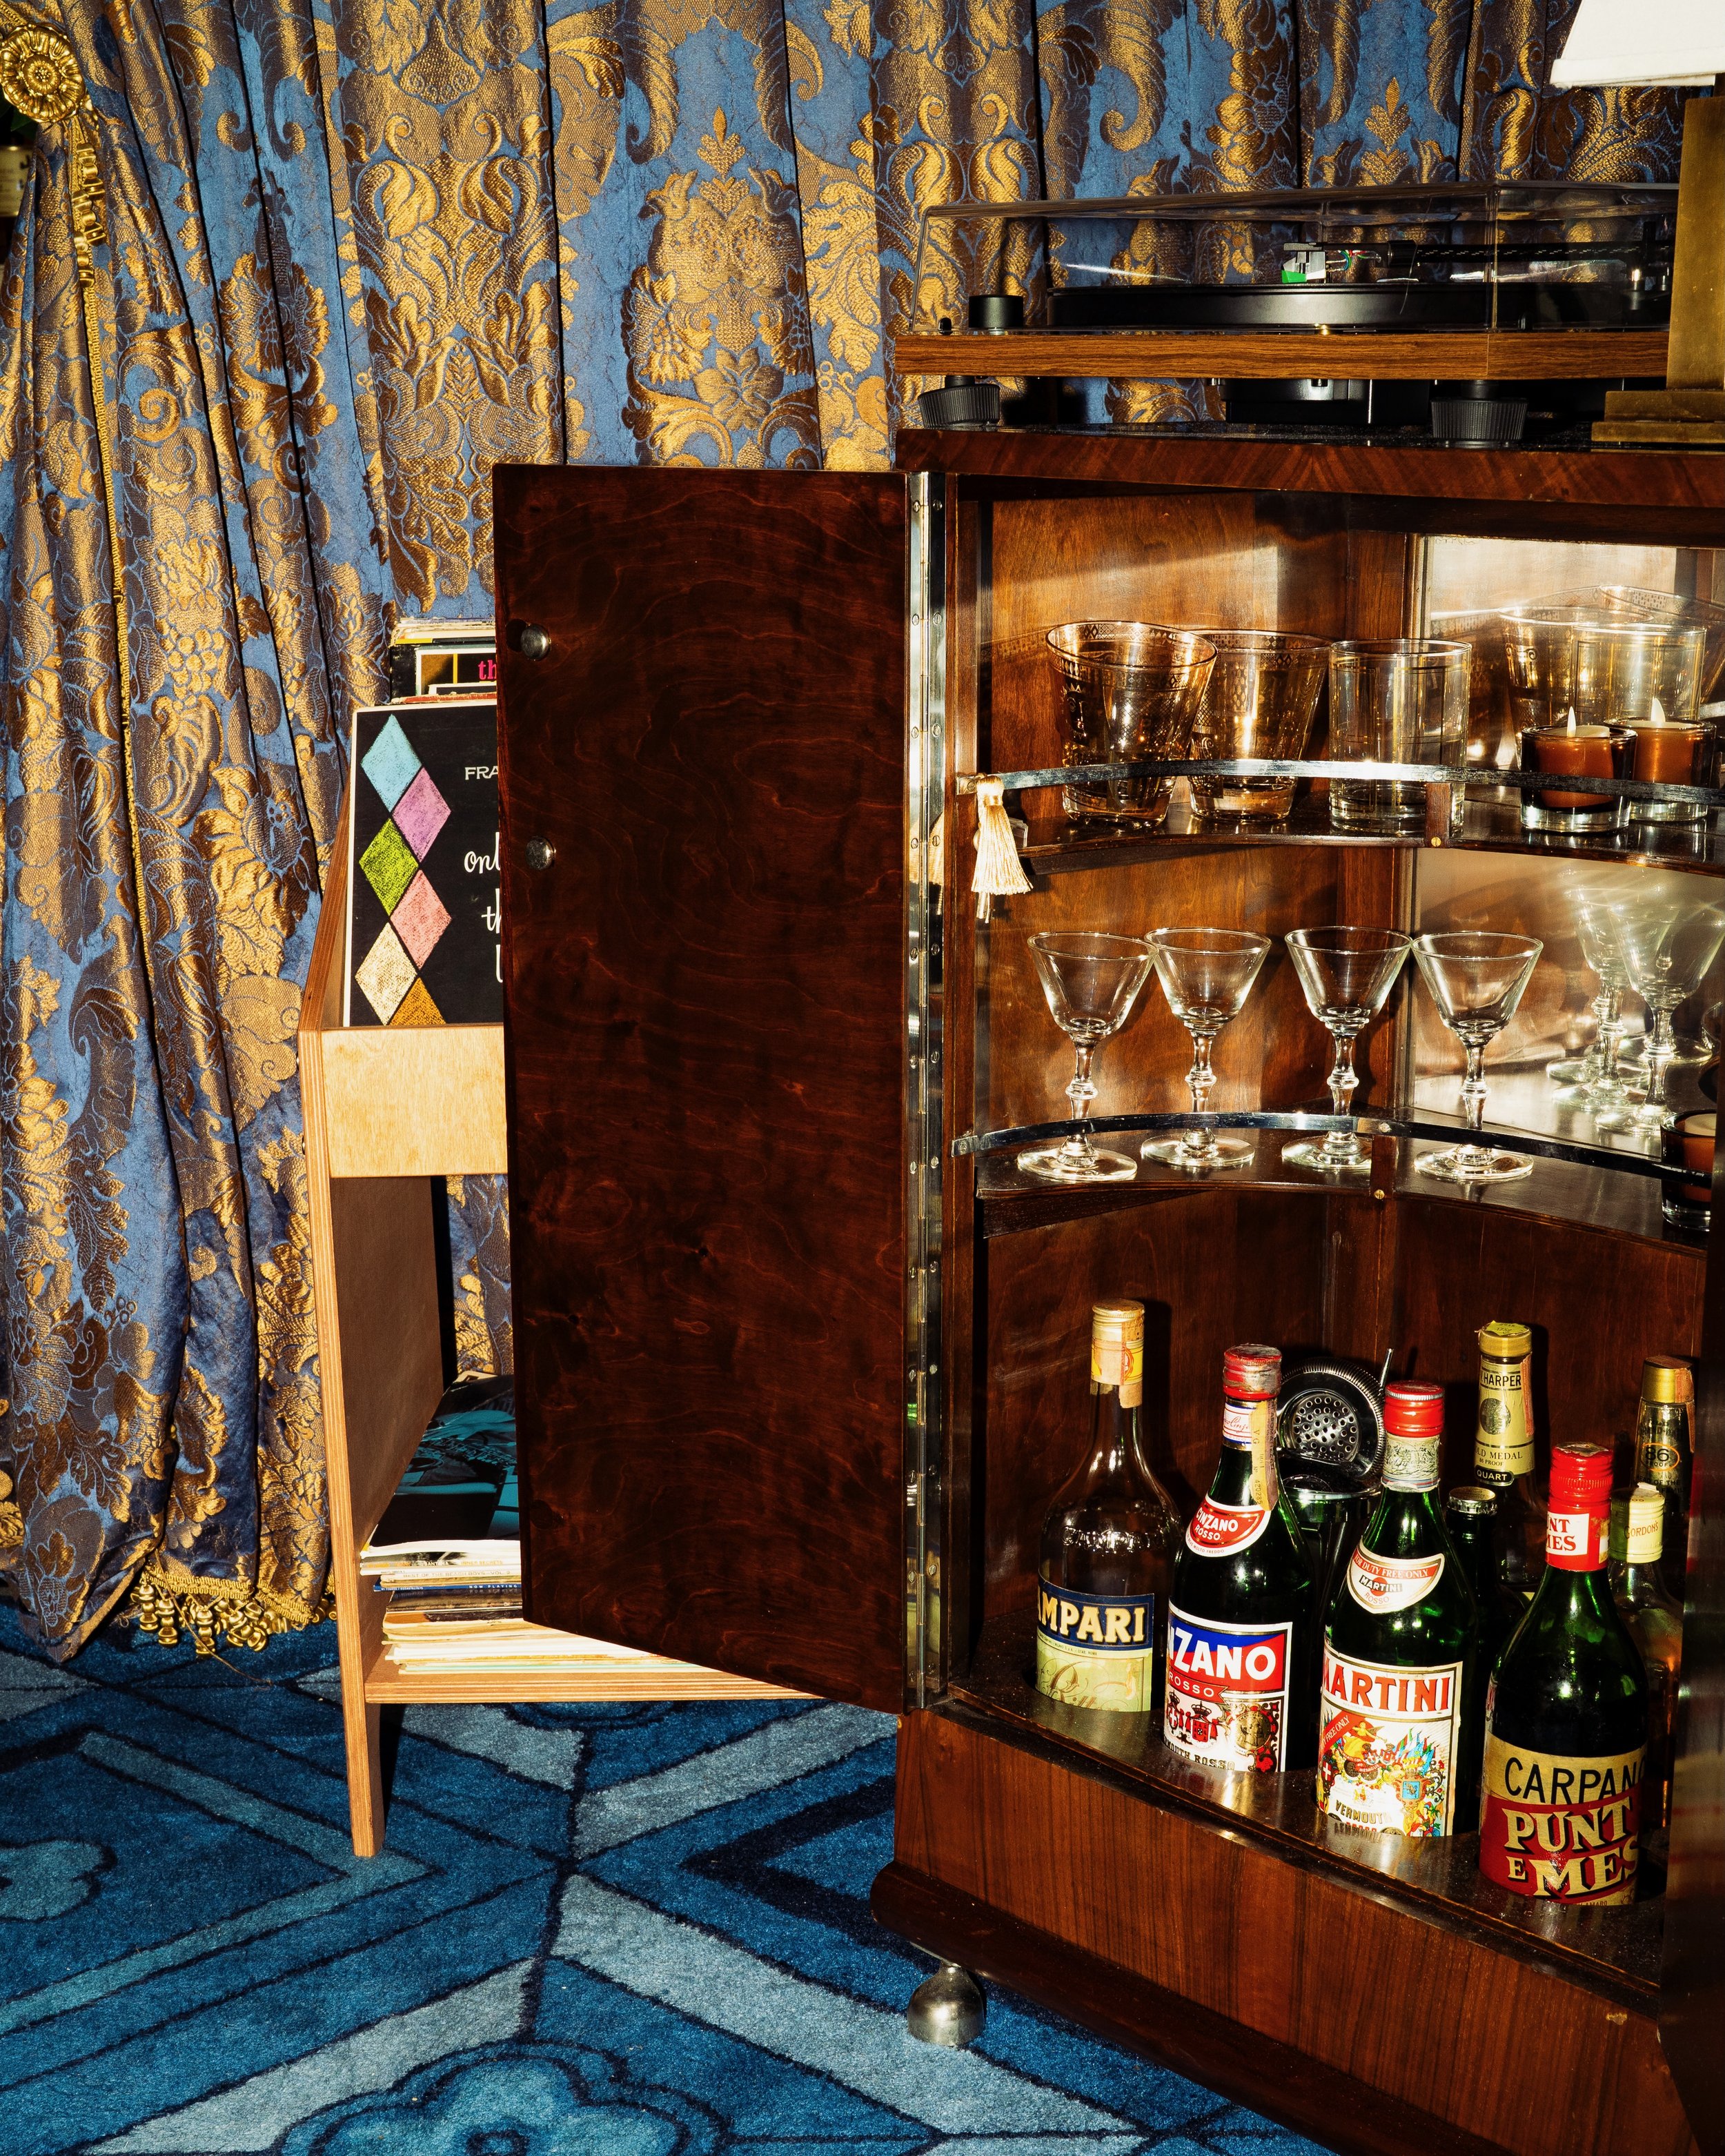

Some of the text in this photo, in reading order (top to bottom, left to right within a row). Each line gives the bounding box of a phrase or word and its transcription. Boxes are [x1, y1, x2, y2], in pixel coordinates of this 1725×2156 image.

[1483, 1374, 1521, 1387] HARPER
[1490, 1448, 1523, 1460] MEDAL
[1646, 1447, 1670, 1461] 86
[1477, 1470, 1508, 1481] QUART
[1196, 1507, 1239, 1532] CINZANO
[1362, 1560, 1381, 1576] DUTY
[1381, 1568, 1403, 1579] FREE
[1406, 1569, 1429, 1579] ONLY
[1359, 1574, 1402, 1592] MARTINI
[1364, 1592, 1390, 1604] ROSSO
[1169, 1671, 1214, 1697] ROSSO
[1335, 1715, 1350, 1732] ONLY
[1501, 1796, 1631, 1855] PUNT
[1506, 1834, 1639, 1899] E MES
